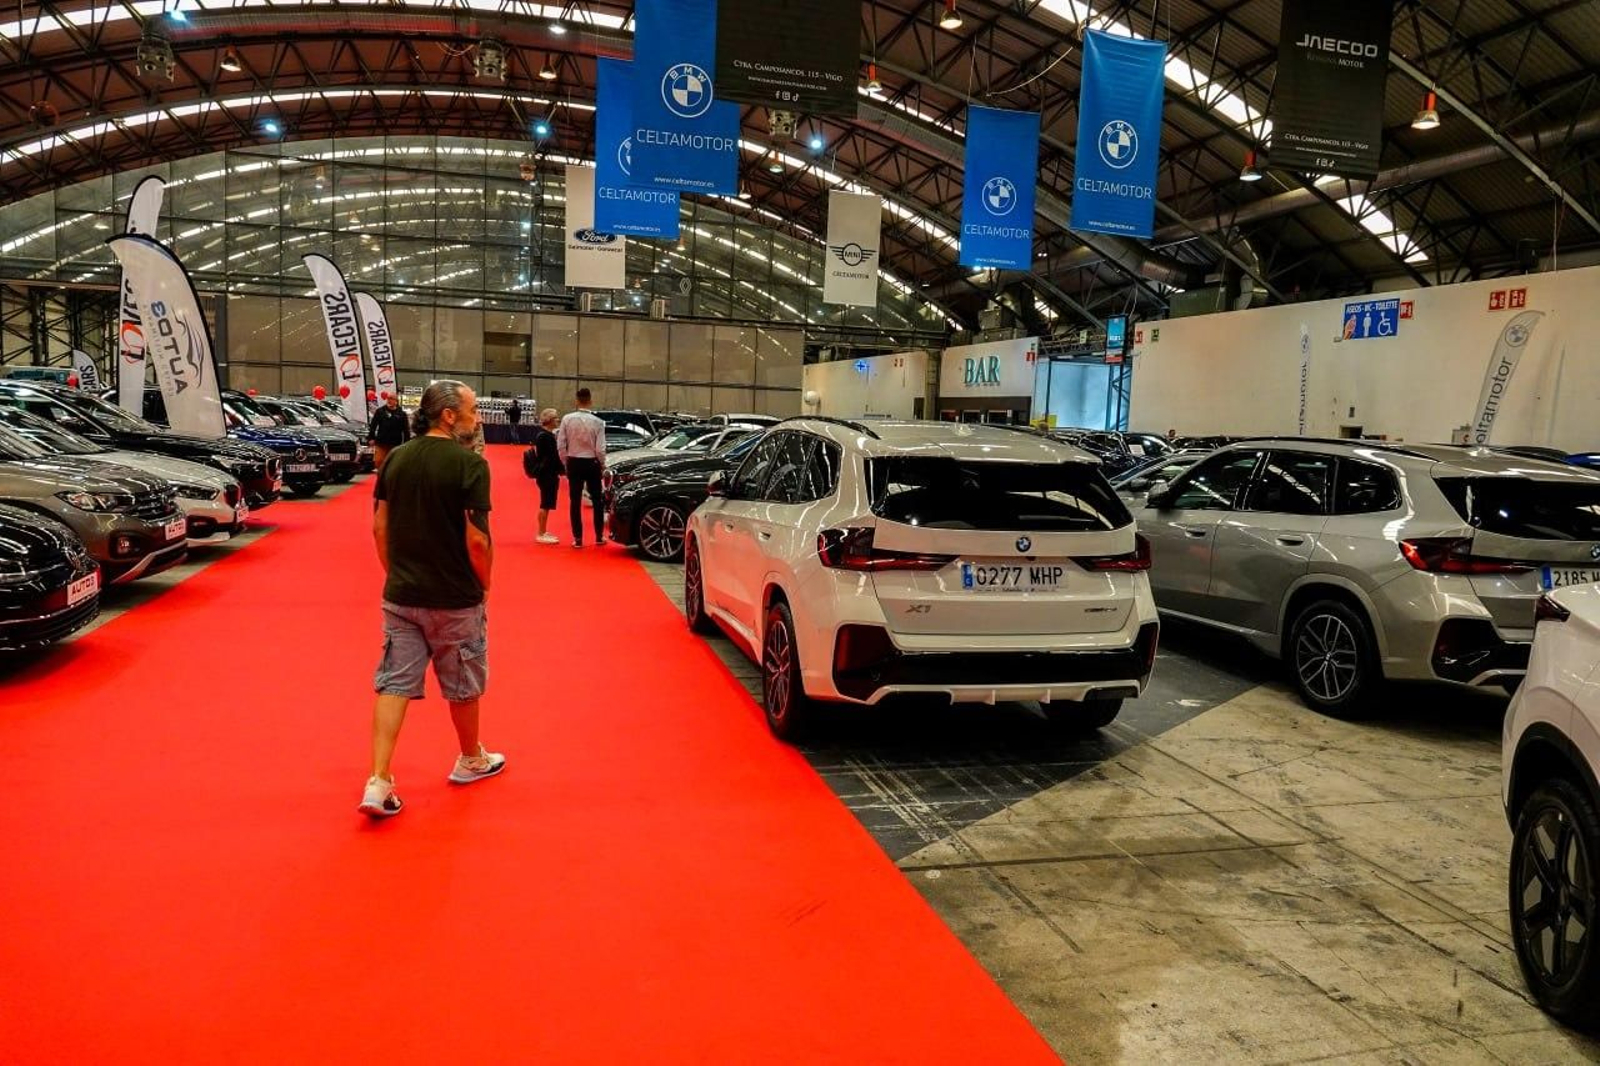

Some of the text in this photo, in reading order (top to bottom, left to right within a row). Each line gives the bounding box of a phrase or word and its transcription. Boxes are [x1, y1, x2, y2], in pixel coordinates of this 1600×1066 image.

[1295, 33, 1378, 58] JAECOO
[636, 129, 734, 153] CELTAMOTOR
[598, 186, 677, 205] CELTAMOTOR
[1077, 177, 1152, 200] CELTAMOTOR
[581, 229, 610, 243] Ford
[964, 224, 1031, 240] CELTAMOTOR
[963, 356, 1000, 385] BAR
[1475, 356, 1513, 444] eltamotor
[976, 566, 1063, 586] 0277 MHP
[1553, 570, 1589, 587] 2185
[905, 604, 931, 614] X1
